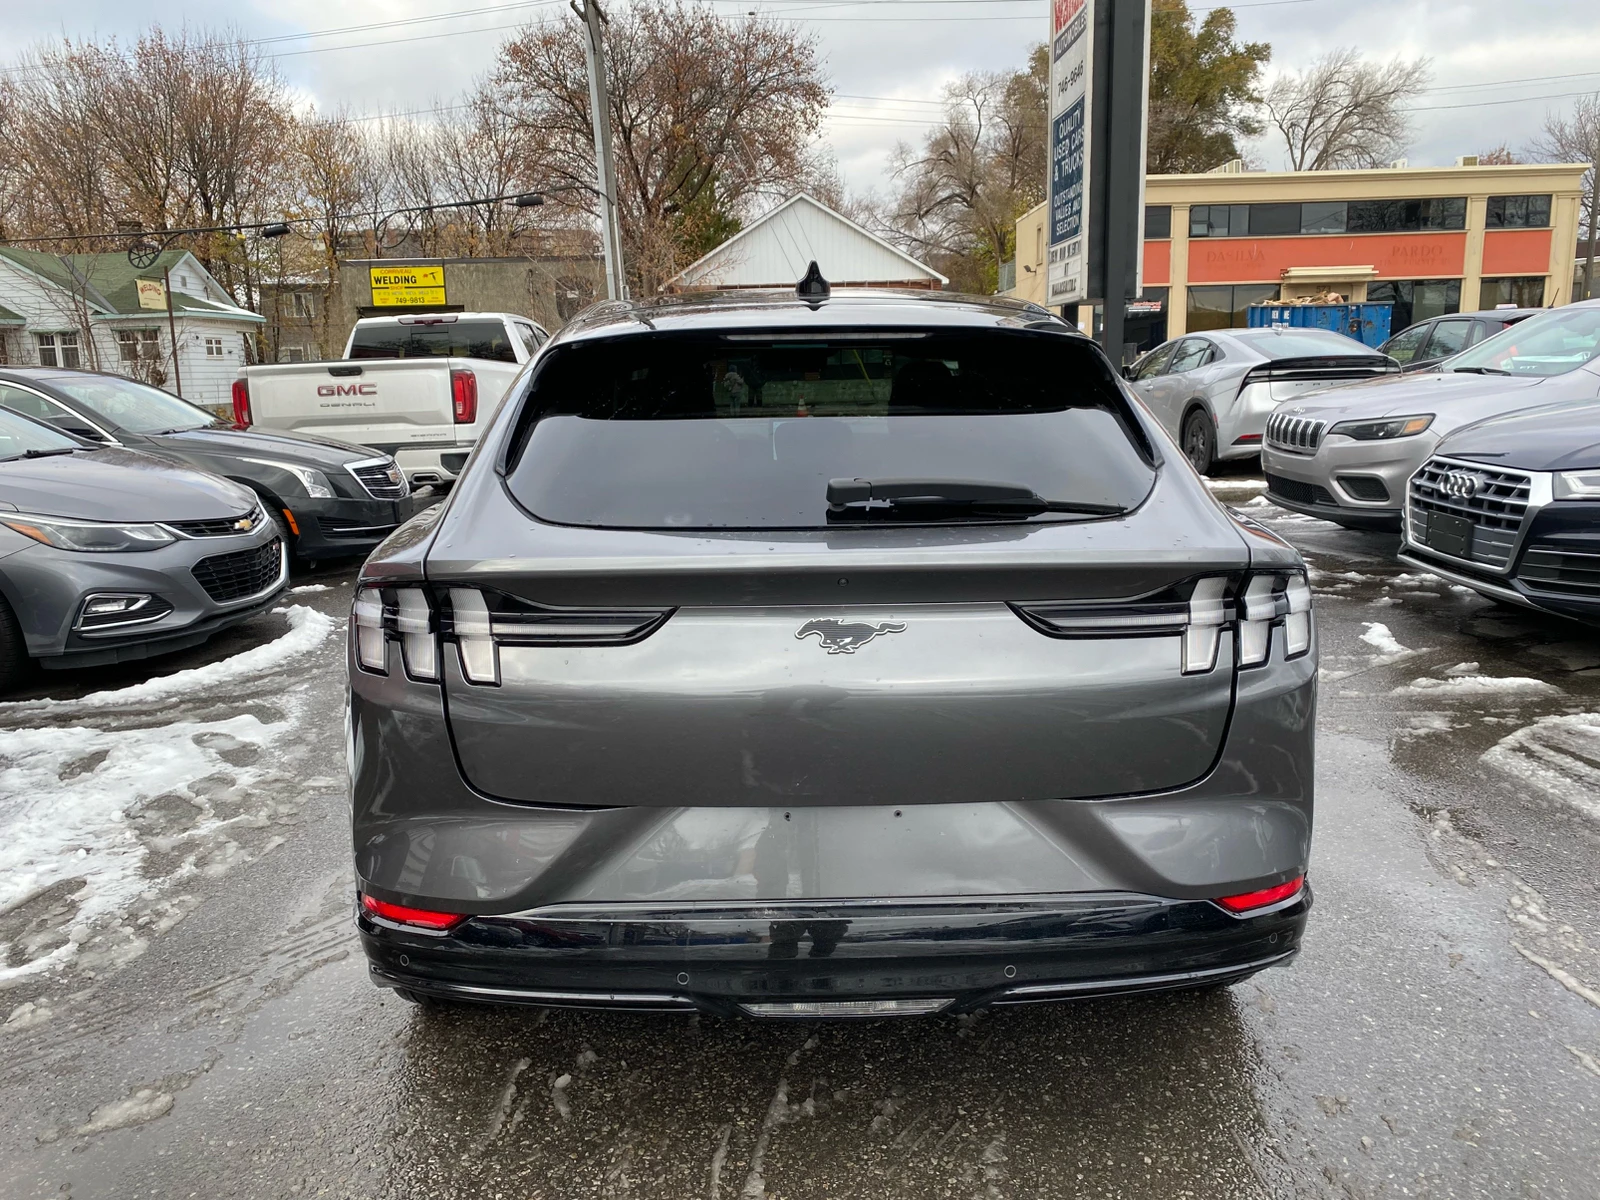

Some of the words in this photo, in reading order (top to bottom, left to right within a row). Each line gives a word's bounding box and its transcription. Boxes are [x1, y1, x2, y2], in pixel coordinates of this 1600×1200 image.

[1056, 8, 1088, 57] AUTOMOBILES
[1059, 108, 1081, 139] QUALITY
[1054, 138, 1070, 161] USED
[1071, 125, 1084, 150] CARS
[1061, 147, 1084, 177] TRUCKS
[1056, 213, 1080, 236] SELECTION
[139, 283, 162, 296] WELDING
[373, 275, 417, 285] WELDING
[317, 384, 377, 397] GMC
